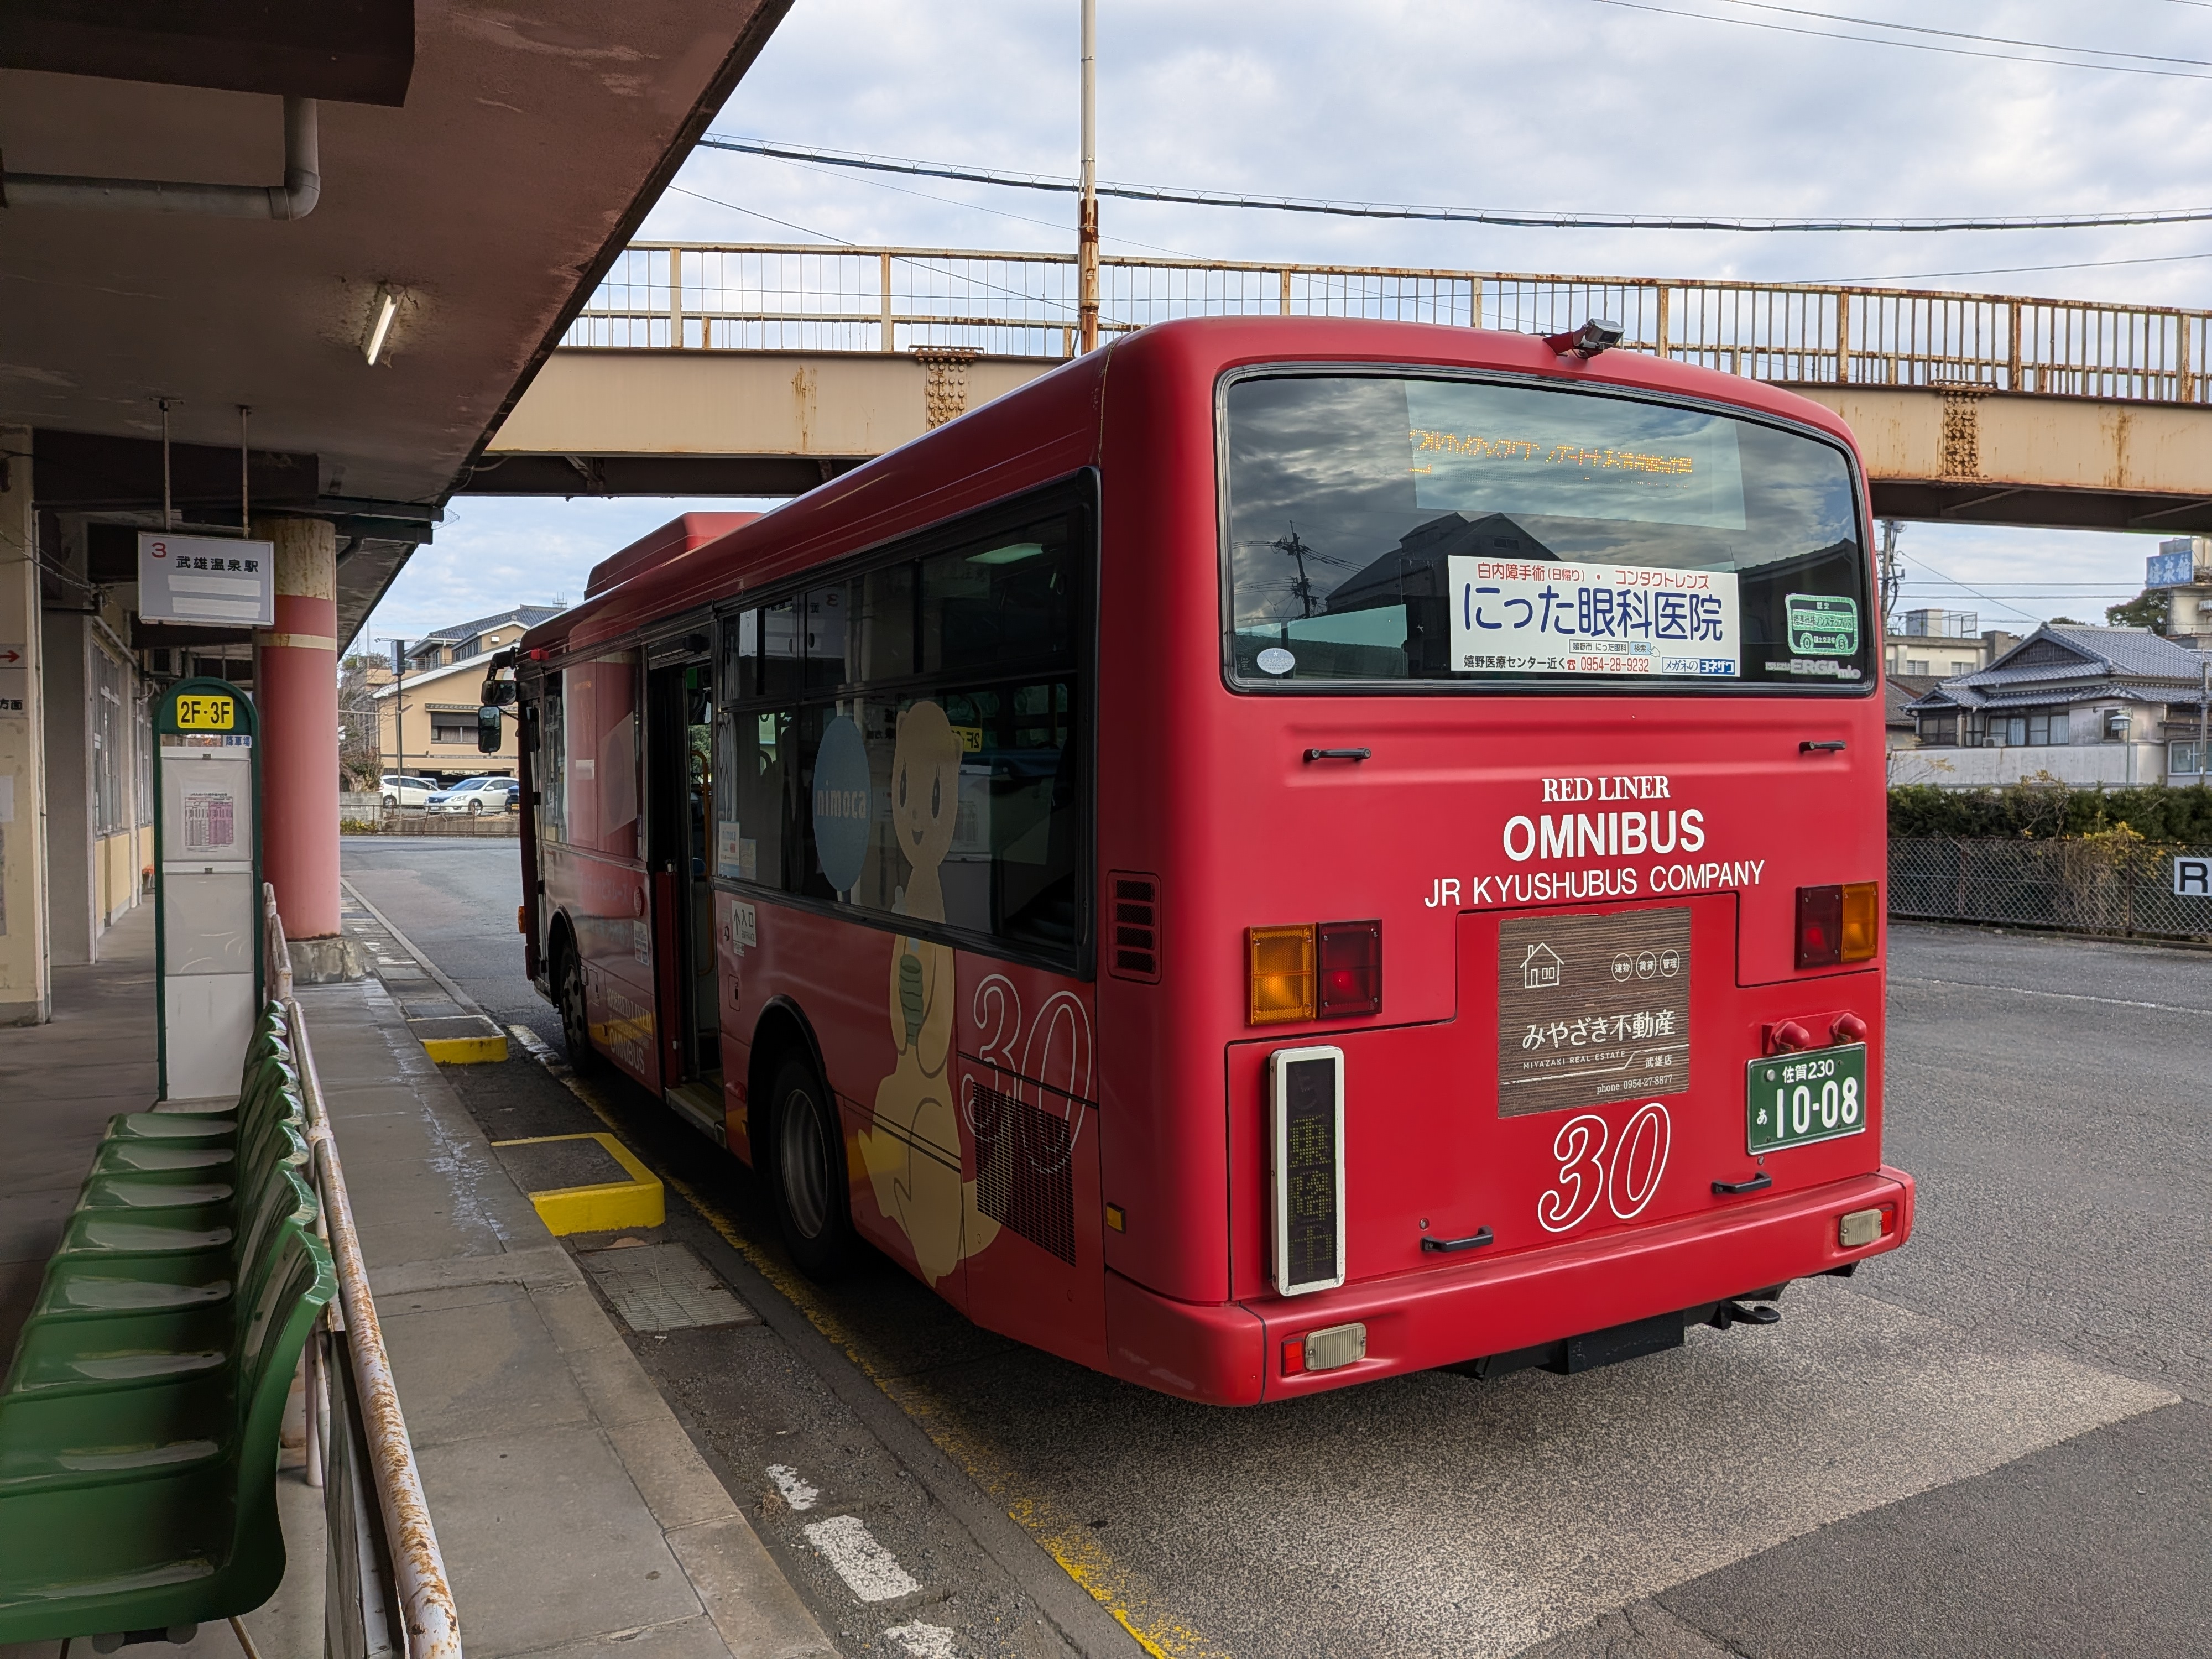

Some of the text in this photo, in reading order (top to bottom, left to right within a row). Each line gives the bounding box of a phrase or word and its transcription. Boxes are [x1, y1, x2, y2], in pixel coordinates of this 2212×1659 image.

[151, 542, 167, 559] 3
[176, 555, 259, 573] 武雄温泉駅
[1615, 570, 1709, 589] コンタクトレンズ
[1464, 583, 1723, 641] にった眼科医院
[1595, 642, 1627, 654] にった眼科
[1634, 644, 1646, 654] 検索
[1464, 655, 1566, 670] 嬉野医療センター近く
[1580, 656, 1650, 672] 0954-28-9232
[0, 698, 23, 711] 方面
[1541, 775, 1671, 802] RED LINER
[816, 779, 868, 820] nimoca
[1503, 808, 1705, 862] OMNIBUS
[1425, 859, 1765, 908] JR KYUSHUBUS COMPANY
[742, 909, 754, 928] 入口
[1662, 957, 1678, 969] 管理
[1522, 1009, 1676, 1051] みやざき不動産
[609, 1028, 645, 1075] OMNIBUS
[1522, 1050, 1626, 1070] MIYAZAKI REAL ESTATE
[1645, 1054, 1673, 1068] 武雄店
[961, 974, 1091, 1173] 30
[1596, 1074, 1673, 1094] phone 0954-27-8877
[1756, 1076, 1858, 1139] あ 10-08
[1537, 1102, 1671, 1233] 30
